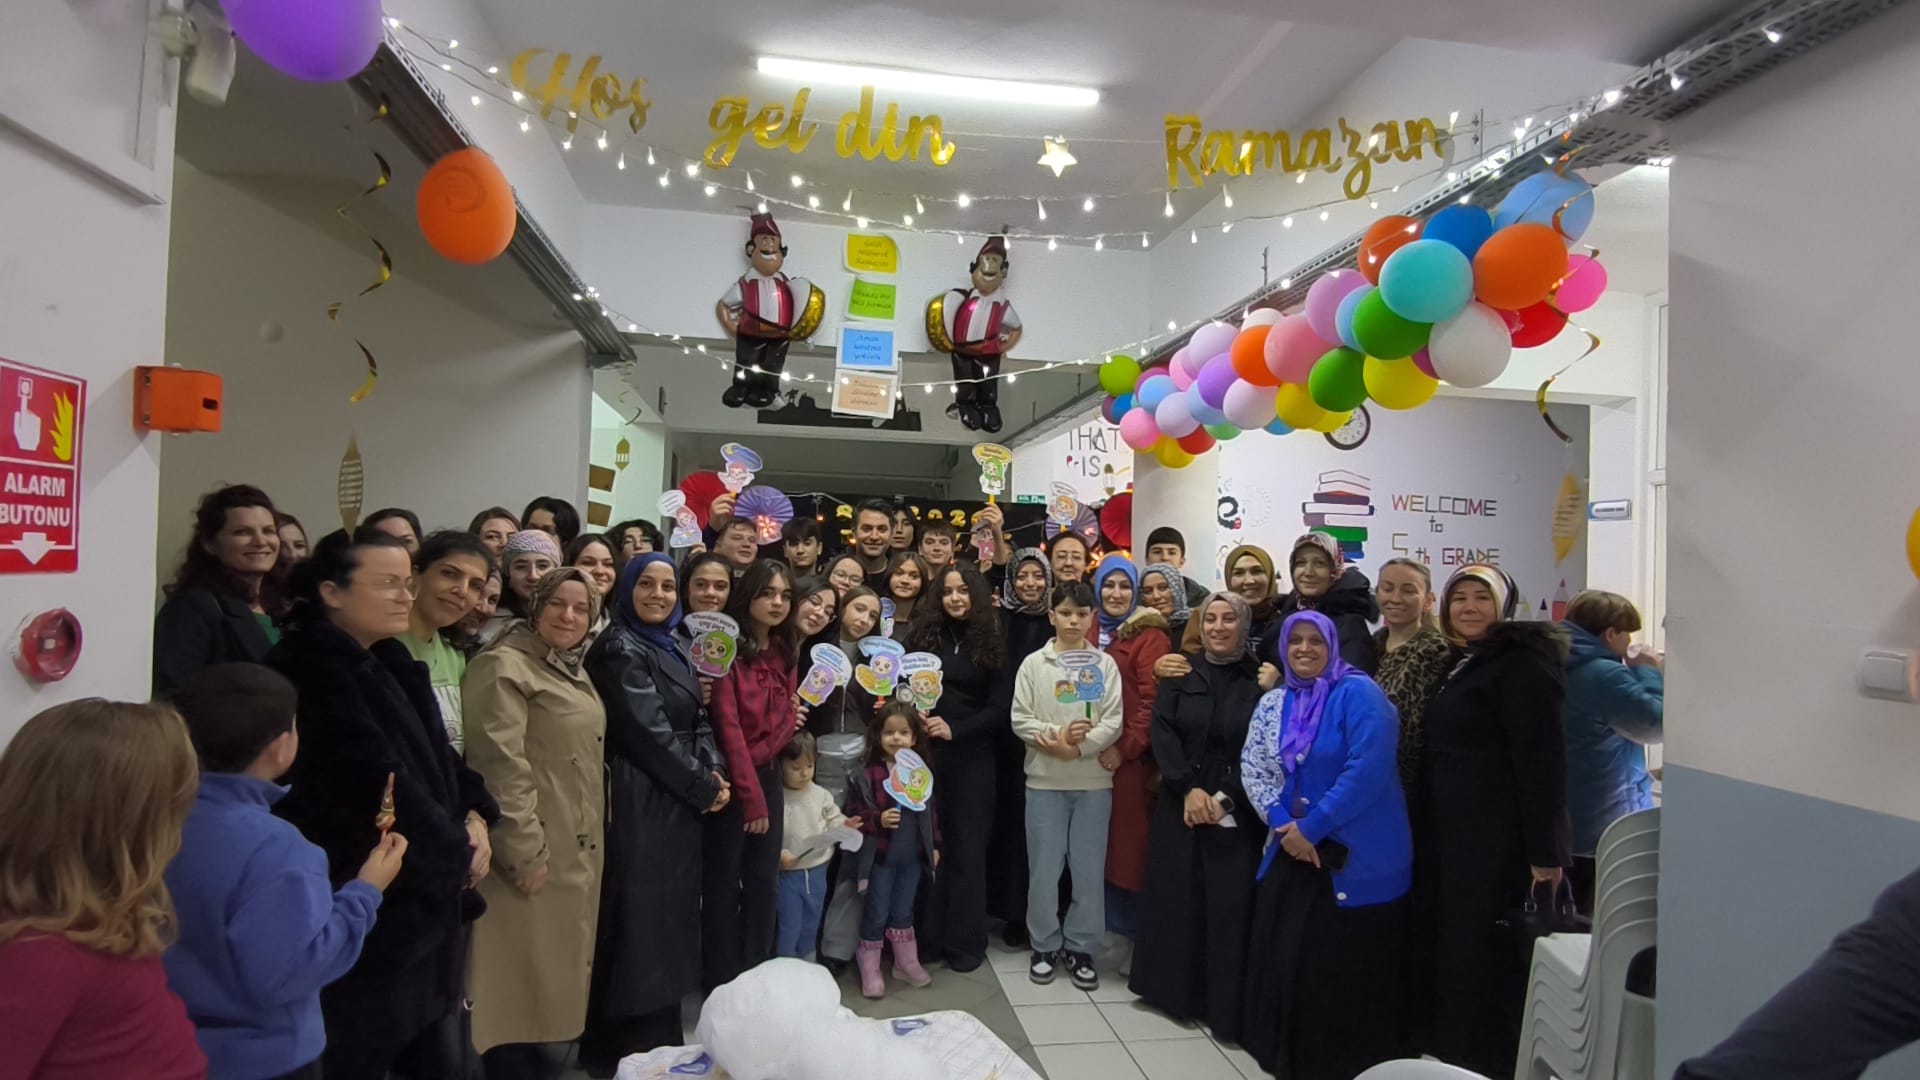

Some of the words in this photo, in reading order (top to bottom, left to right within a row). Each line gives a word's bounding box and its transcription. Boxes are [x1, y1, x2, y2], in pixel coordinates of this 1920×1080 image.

[1164, 114, 1447, 200] Ramazan
[1066, 426, 1121, 451] THAT
[1082, 455, 1102, 477] IS
[4, 472, 66, 497] ALARM
[0, 503, 71, 528] BUTONU
[1392, 494, 1497, 517] WELCOME
[1428, 515, 1443, 533] to
[1442, 547, 1500, 566] GRADE
